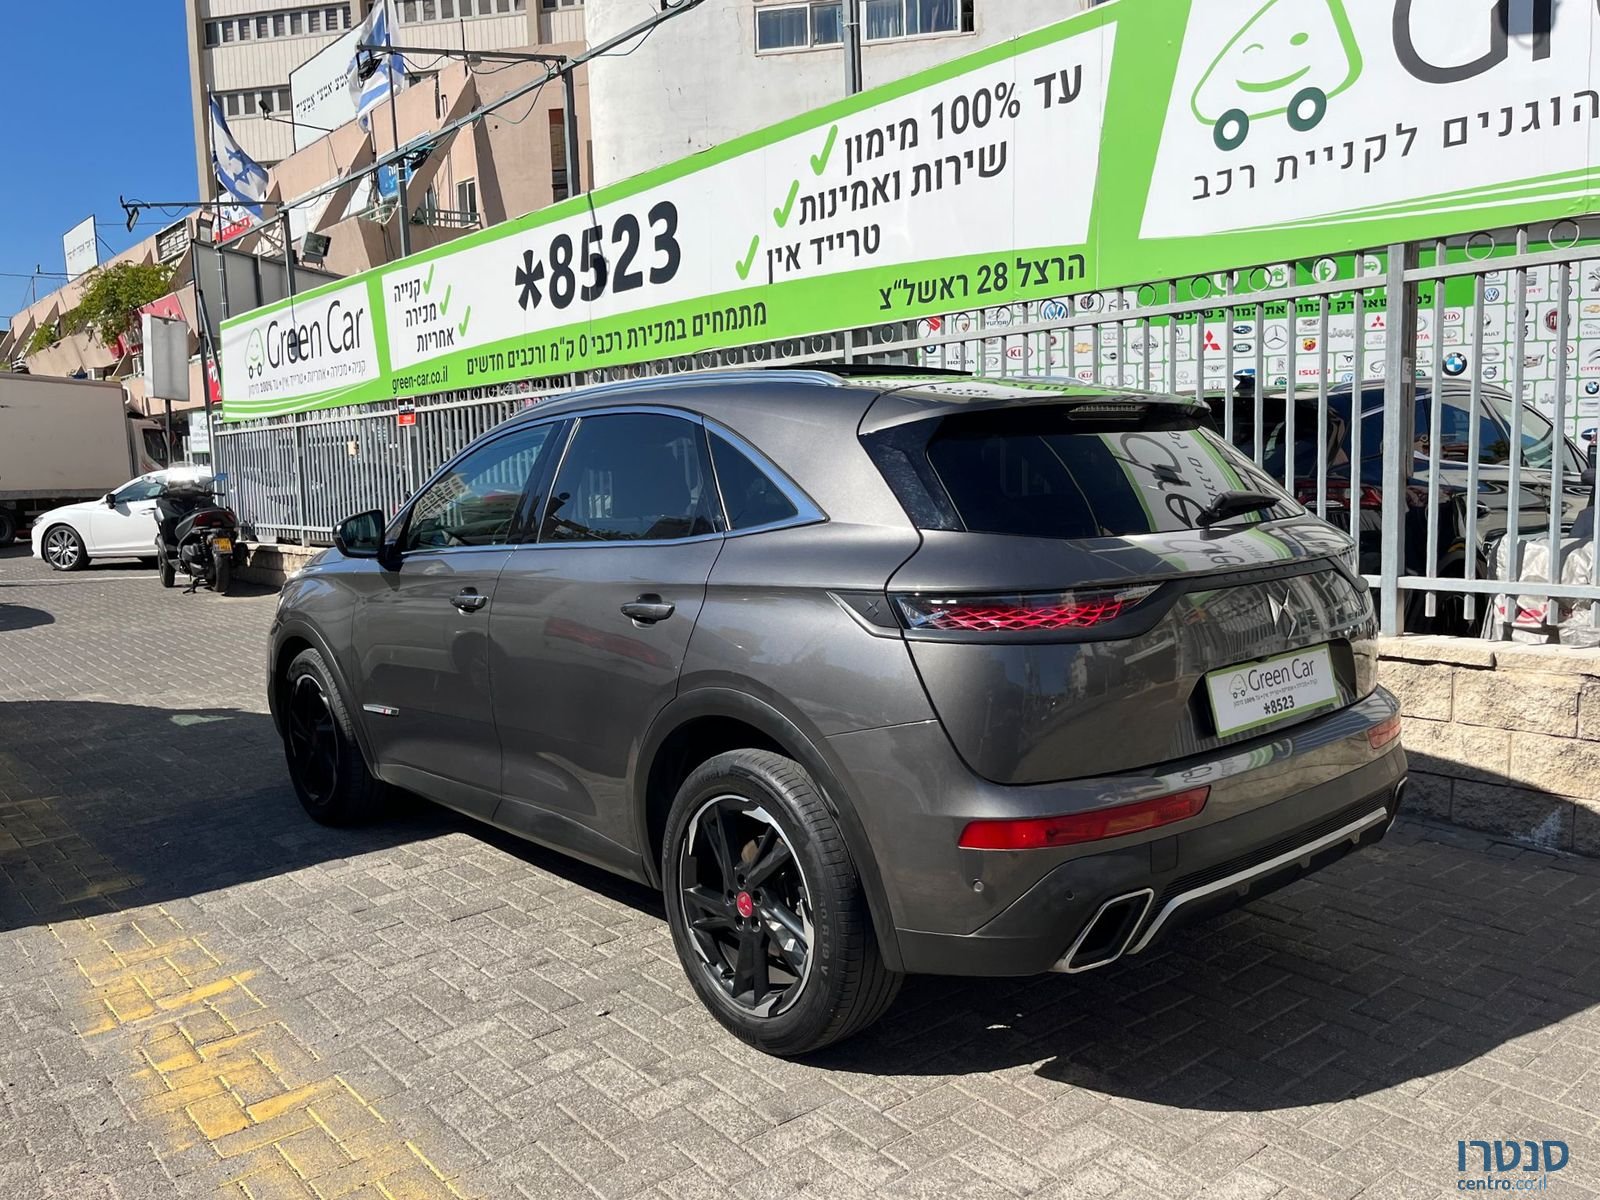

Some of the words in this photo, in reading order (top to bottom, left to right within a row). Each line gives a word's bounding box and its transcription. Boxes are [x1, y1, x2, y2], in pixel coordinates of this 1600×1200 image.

[1034, 64, 1082, 109] עד
[931, 81, 1021, 140] 100%
[1443, 89, 1599, 148] הוגנים
[845, 117, 919, 176] מימון
[1274, 122, 1418, 184] לקניית
[910, 140, 1007, 197] שירות
[1192, 163, 1255, 200] רכב
[798, 169, 901, 226] ואמינות
[809, 223, 881, 266] טרייד
[766, 242, 801, 285] אין
[976, 262, 1008, 294] 28
[1016, 253, 1086, 288] הרצל
[394, 278, 421, 303] קנייה
[405, 302, 437, 327] מכירה
[692, 301, 767, 337] מתמחים
[266, 320, 323, 369] Green
[327, 300, 364, 354] Car
[417, 327, 455, 353] אחריות
[578, 333, 588, 358] 0
[591, 331, 622, 358] רכבי
[627, 316, 687, 356] במכירת
[466, 349, 505, 376] חדשים
[507, 340, 546, 369] ורכבים
[392, 365, 448, 394] green-car.co.il
[1248, 668, 1290, 692] Green
[1291, 658, 1315, 680] Car
